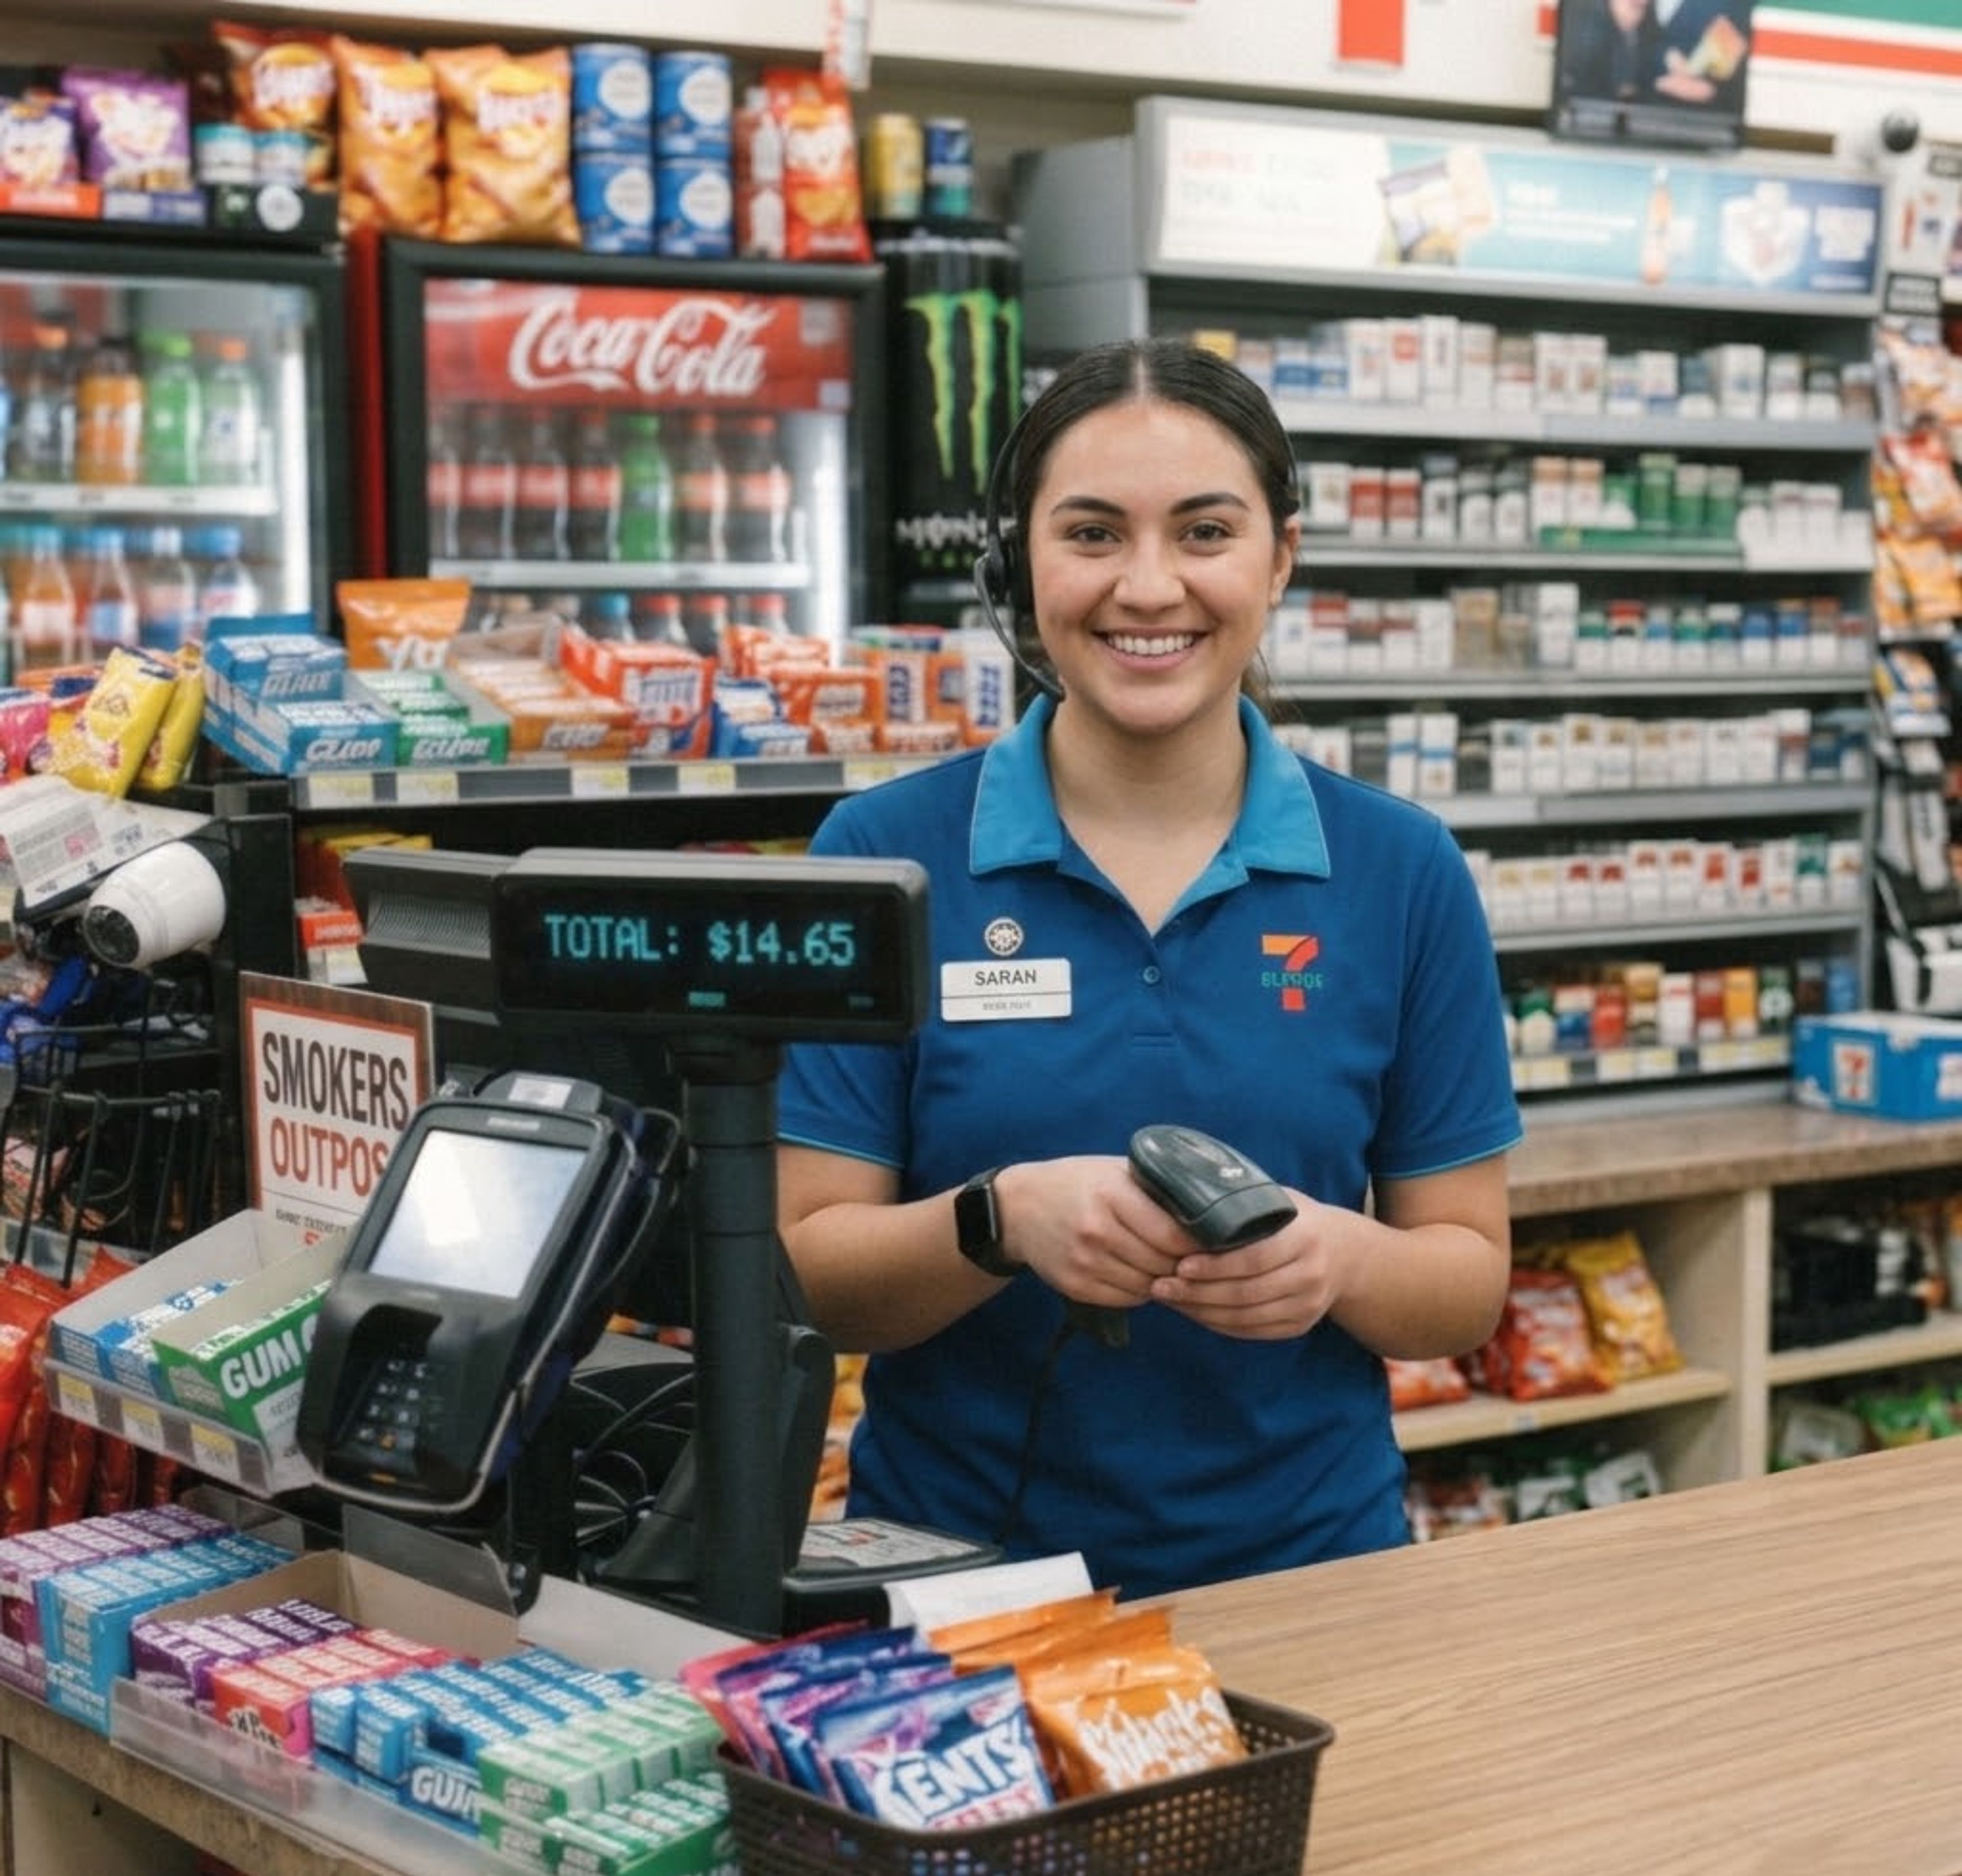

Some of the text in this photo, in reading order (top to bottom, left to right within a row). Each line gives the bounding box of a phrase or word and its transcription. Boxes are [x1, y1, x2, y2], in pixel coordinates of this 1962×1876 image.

[544, 915, 856, 967] TOTAL: $14.65
[974, 969, 1037, 987] SARAN
[262, 1031, 407, 1132] SMOKERS
[271, 1117, 391, 1197] OUTPOS
[221, 1329, 302, 1399] GUM
